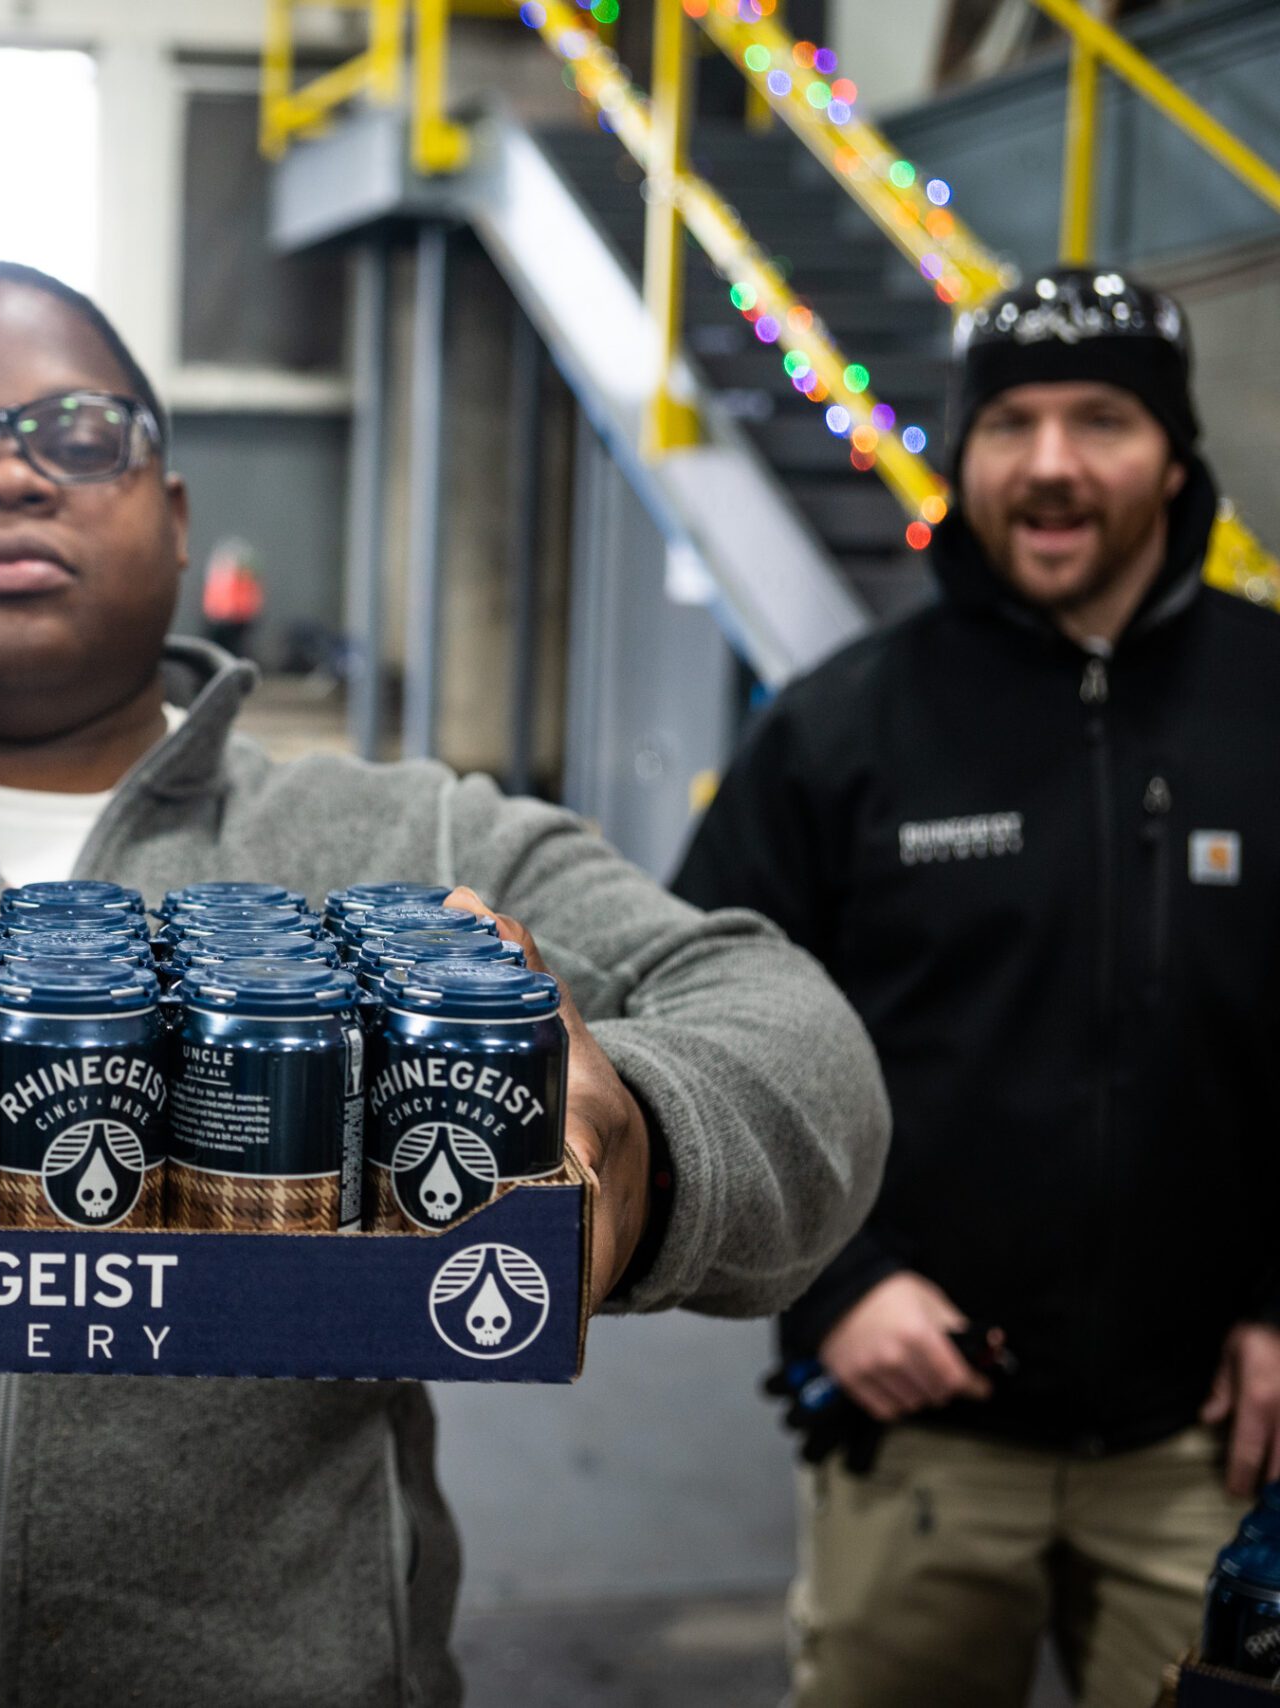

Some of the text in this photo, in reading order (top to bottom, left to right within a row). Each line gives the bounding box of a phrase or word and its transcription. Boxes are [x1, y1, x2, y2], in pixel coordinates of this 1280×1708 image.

[183, 1045, 234, 1066] UNCLE
[208, 1068, 227, 1078] ALE
[370, 1057, 545, 1127] RHINEGEIST
[35, 1095, 89, 1131] CINCY
[110, 1095, 151, 1126] MADE
[387, 1096, 507, 1136] CINCY MADE
